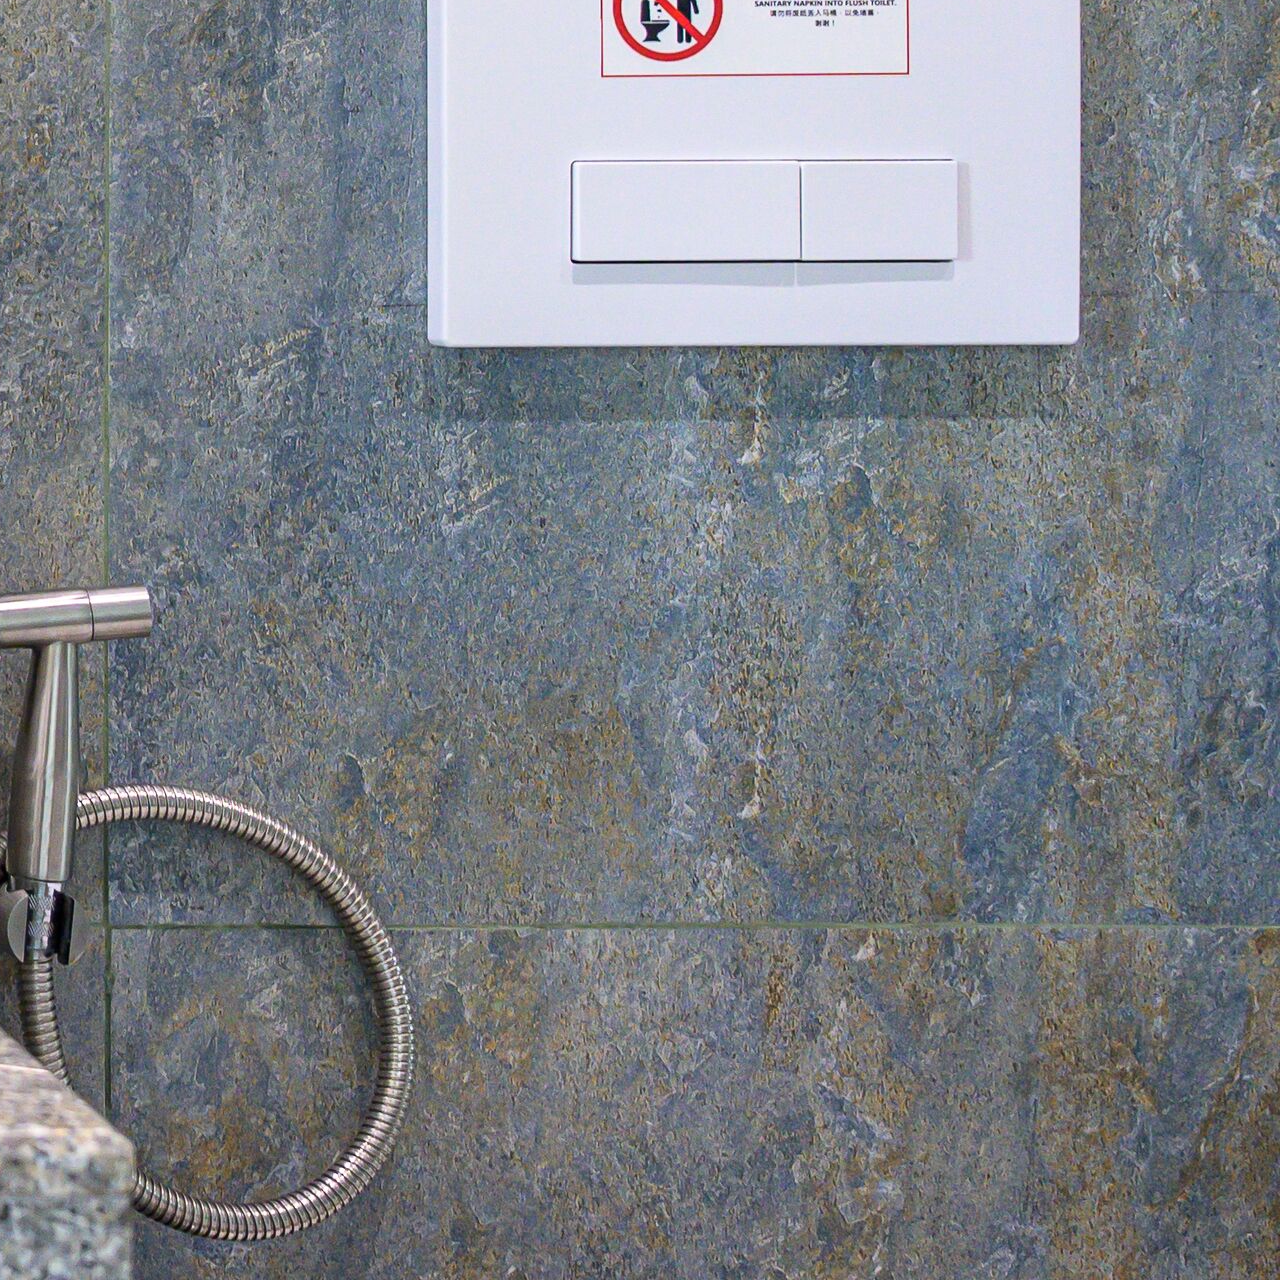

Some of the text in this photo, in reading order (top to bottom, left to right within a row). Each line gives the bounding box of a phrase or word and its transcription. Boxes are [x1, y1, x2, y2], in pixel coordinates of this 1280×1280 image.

[754, 0, 792, 8] SANITARY
[824, 0, 844, 7] INTO
[844, 0, 869, 7] FLUSH
